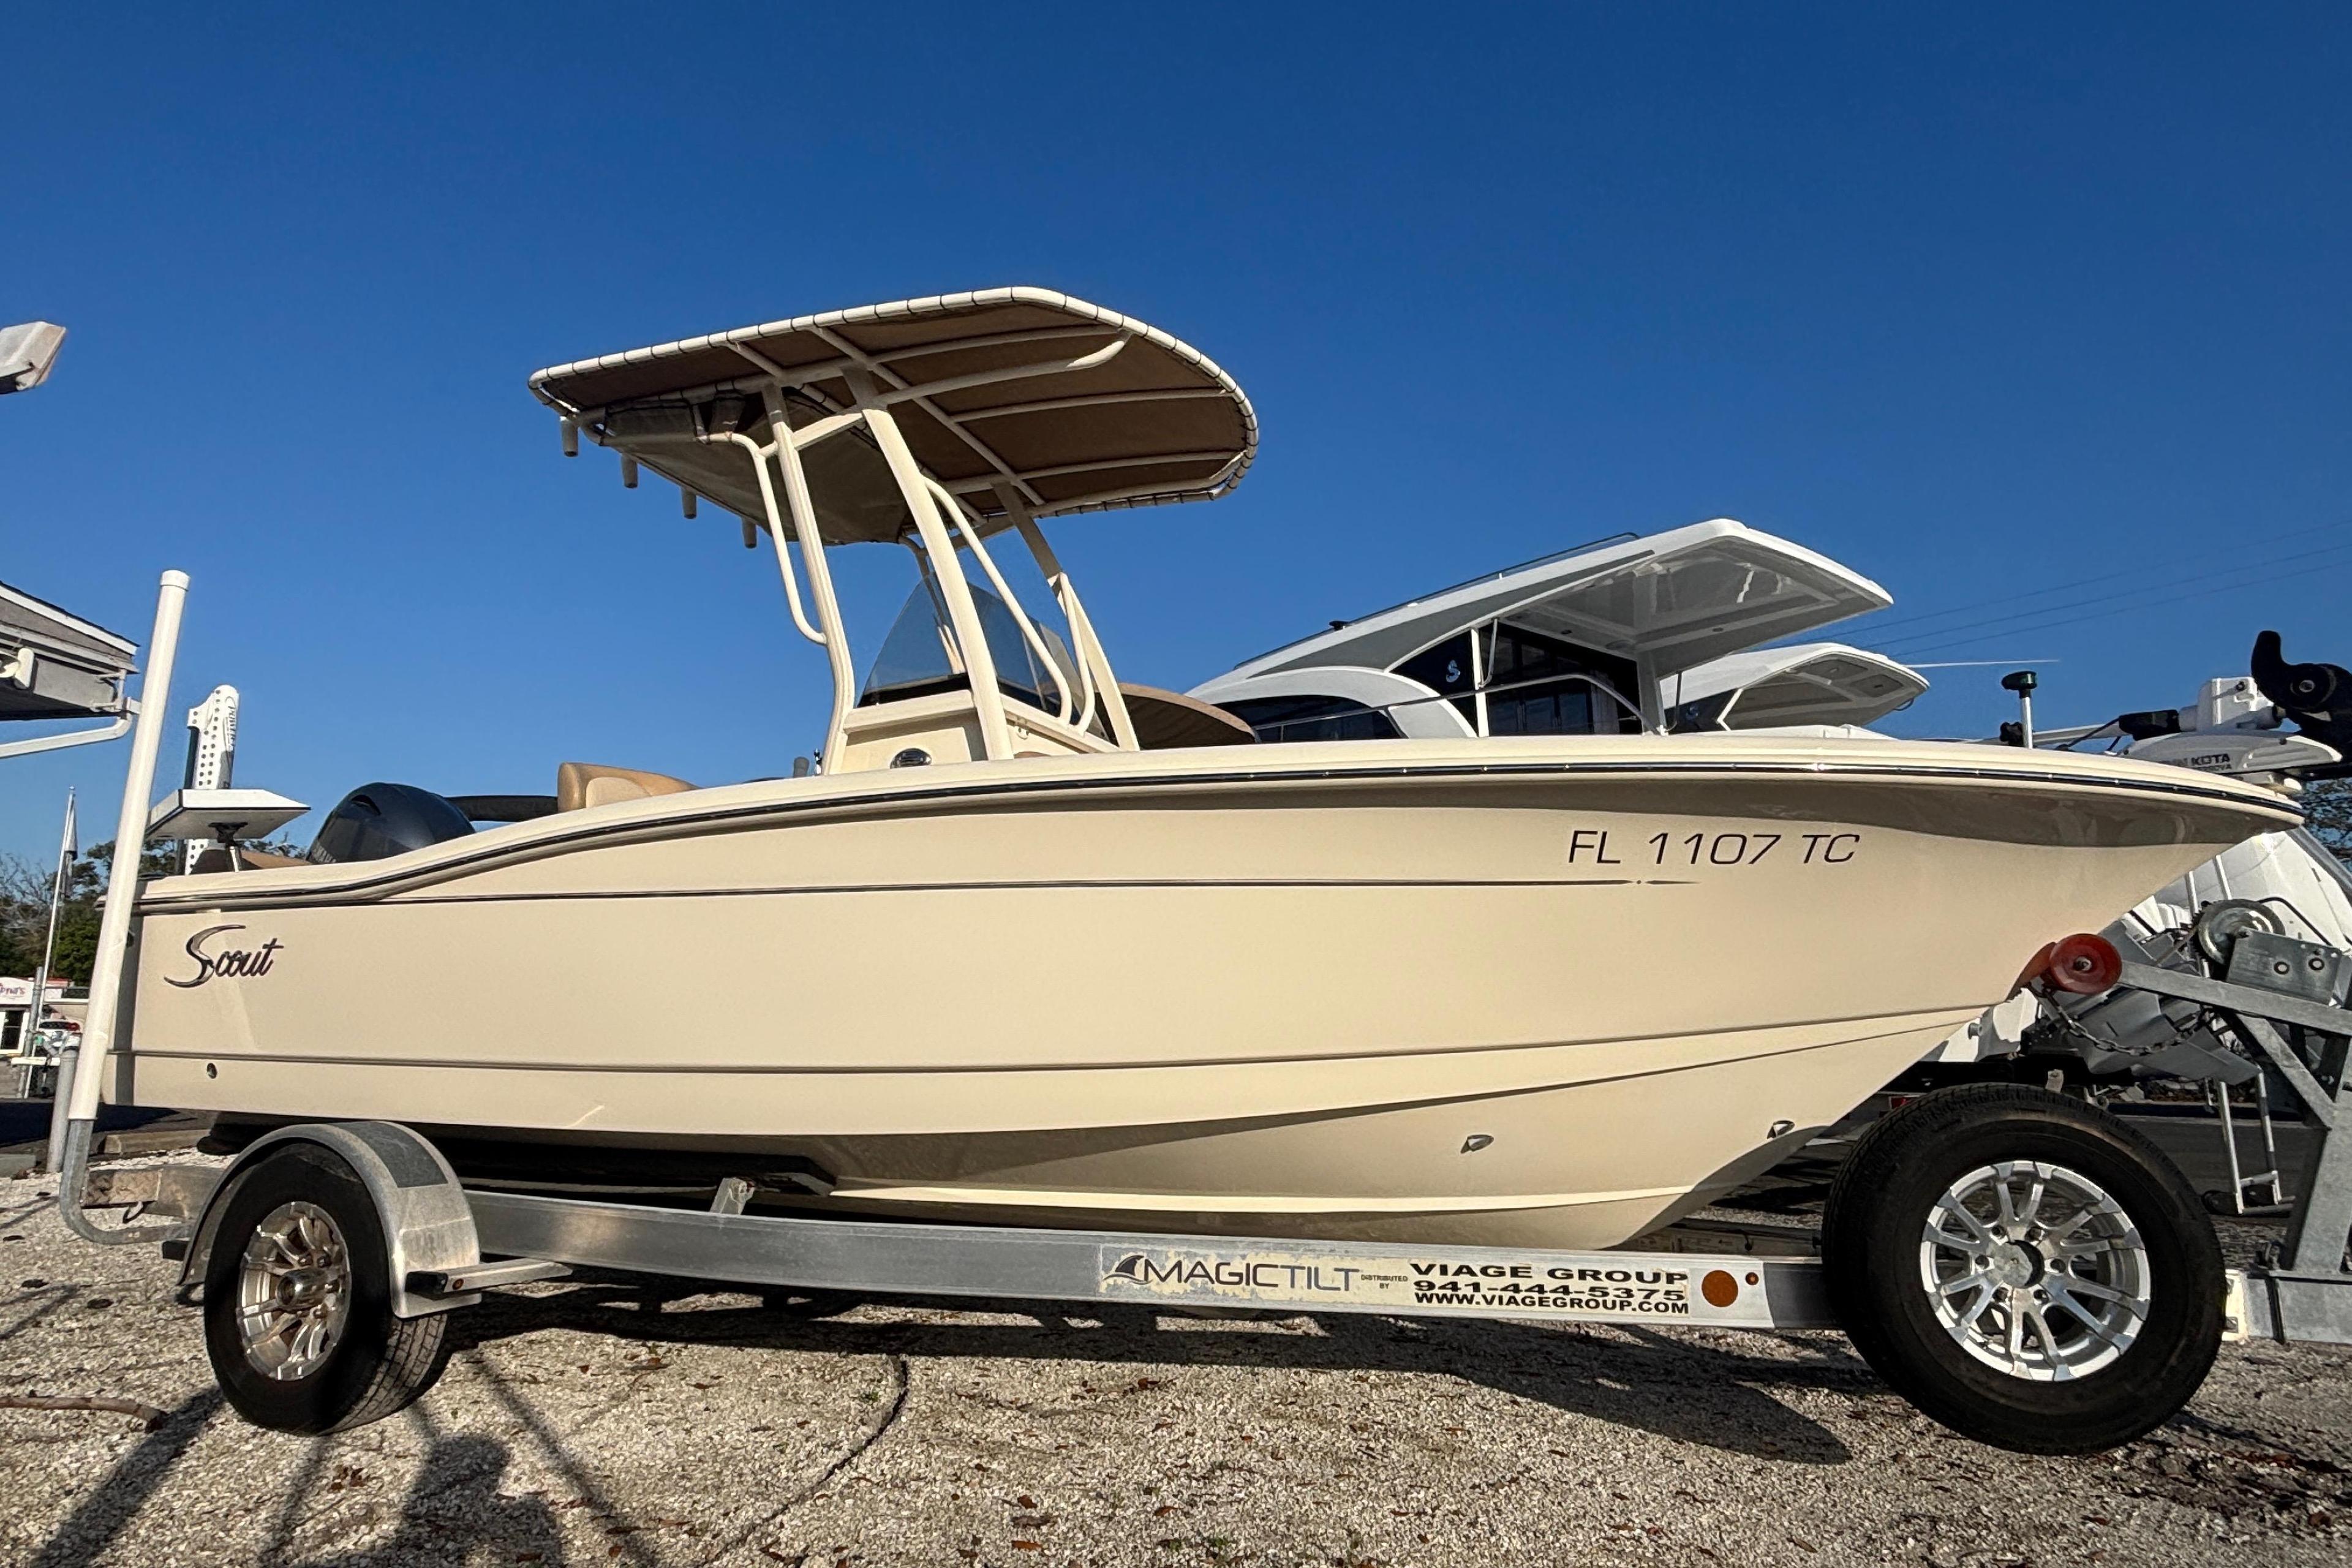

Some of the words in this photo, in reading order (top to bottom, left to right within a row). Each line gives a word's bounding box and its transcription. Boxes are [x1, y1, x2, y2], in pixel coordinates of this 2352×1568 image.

[2191, 753, 2231, 766] KOTA
[1569, 829, 1621, 864] FL
[1648, 832, 1781, 865] 1107
[1802, 834, 1860, 864] TC
[164, 924, 284, 988] Scout
[1144, 1258, 1360, 1292] MAGICTILT
[1410, 1263, 1533, 1279] VIAGE
[1547, 1267, 1689, 1285] GROUP
[1413, 1280, 1686, 1301] 941-444-5375
[1415, 1292, 1689, 1314] WWW.VIAGEGROUP.COM
